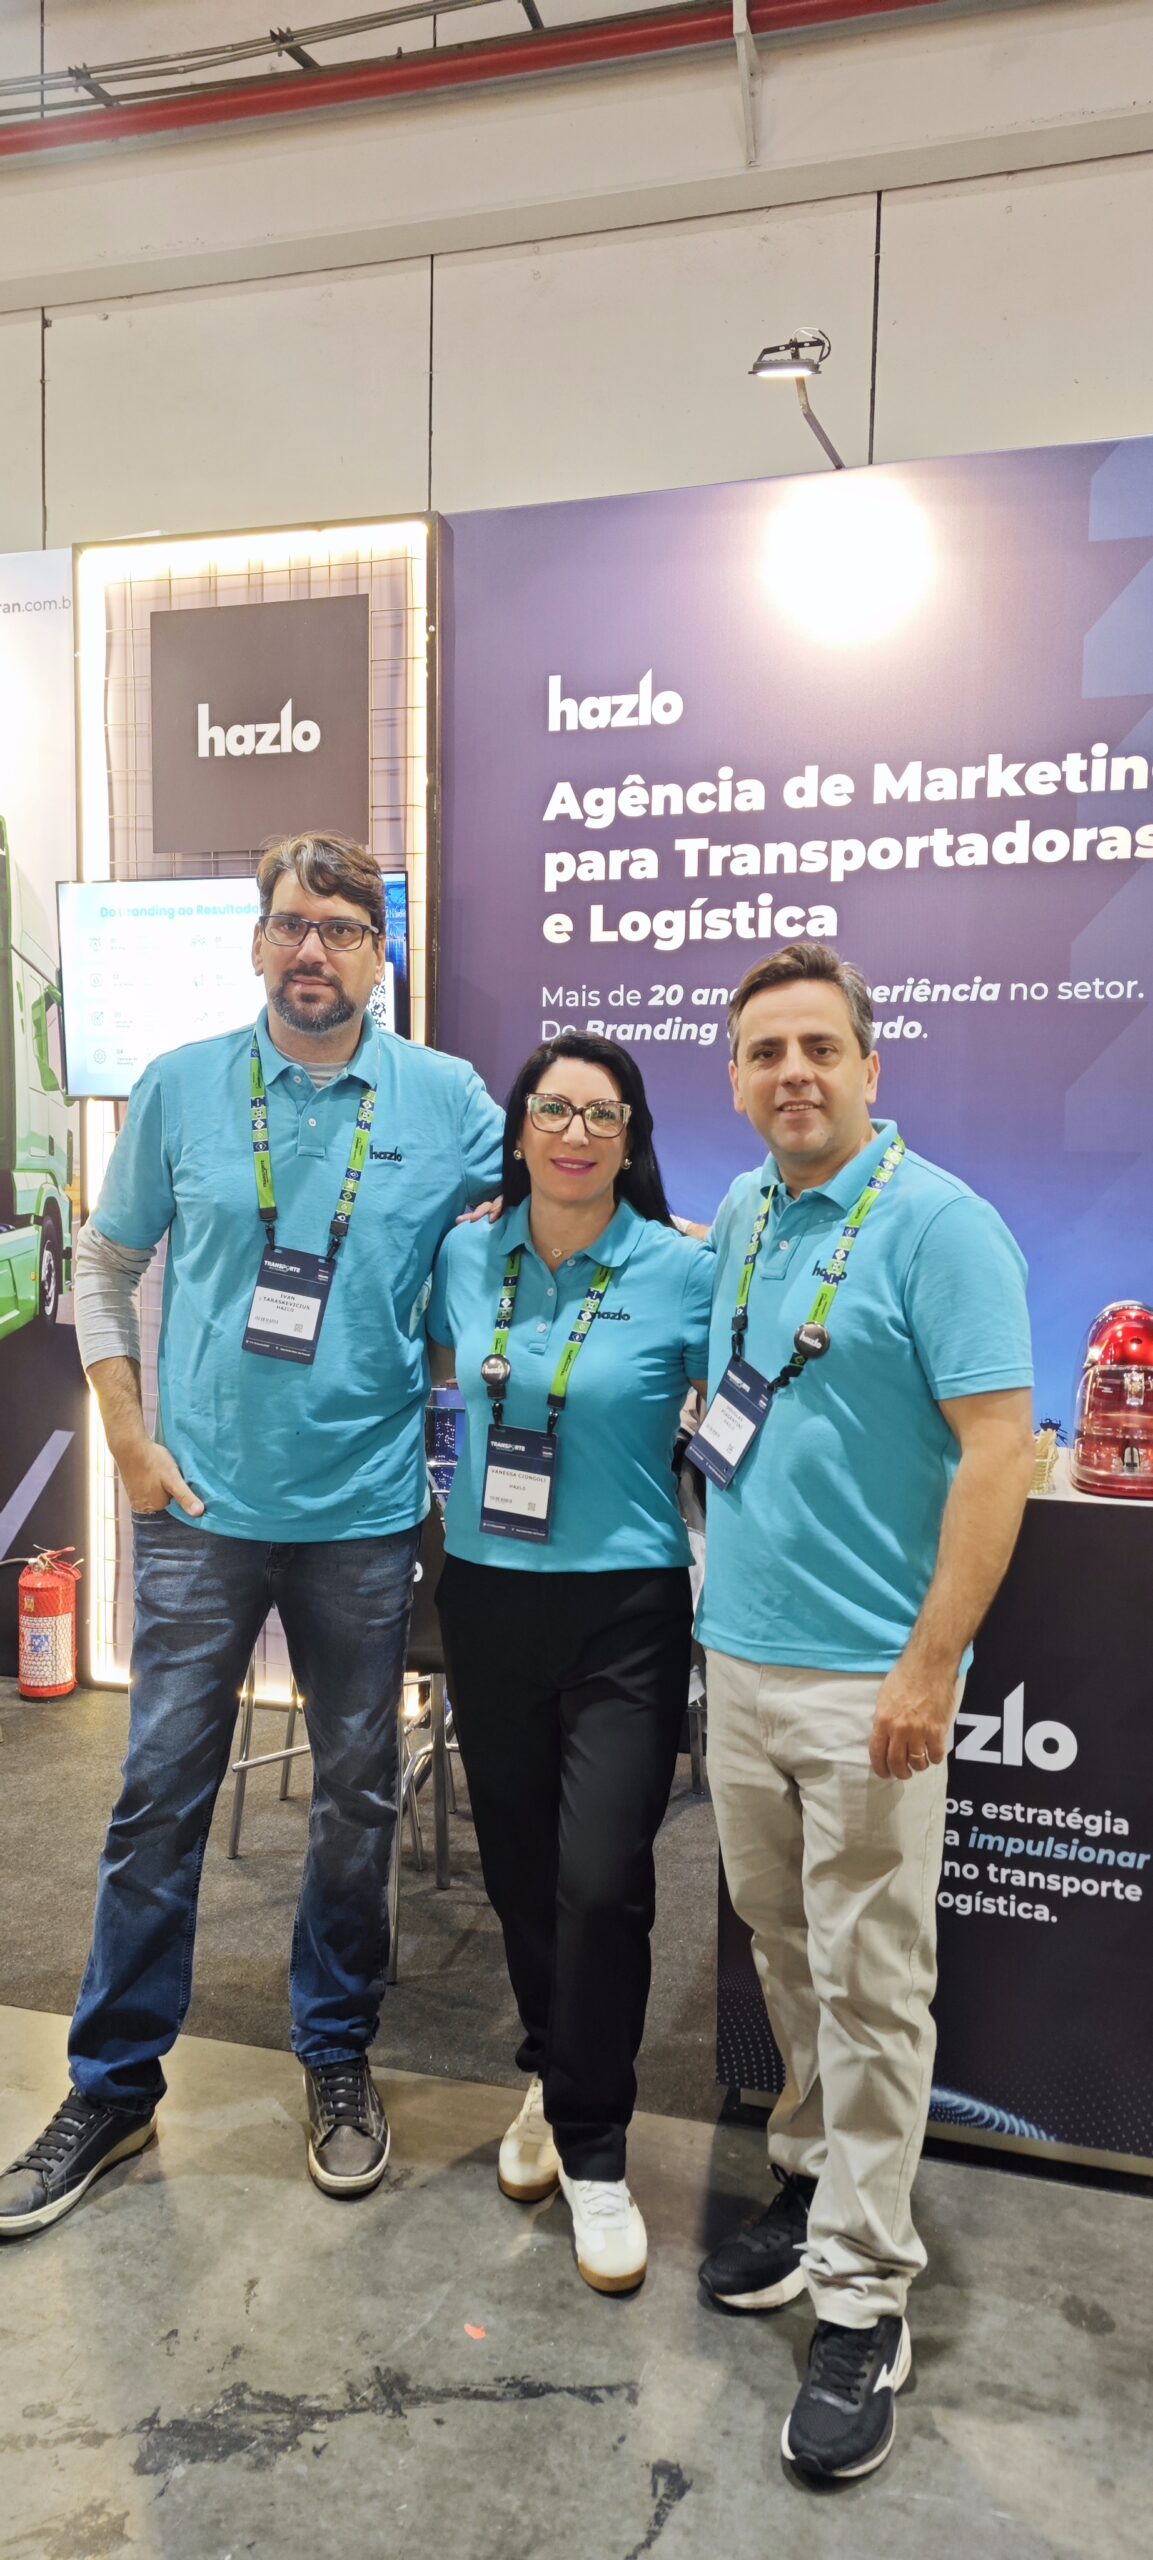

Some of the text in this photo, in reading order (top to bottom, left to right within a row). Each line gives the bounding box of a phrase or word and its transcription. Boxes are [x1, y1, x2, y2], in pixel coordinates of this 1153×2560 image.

[548, 668, 684, 732] hazlo
[197, 698, 321, 758] hazlo
[542, 743, 1153, 829] Agência de Marketin
[544, 820, 1153, 893] para Transportadoras
[119, 904, 175, 920] randing
[542, 893, 838, 951] e Logística
[542, 985, 601, 1007] Mais
[608, 984, 642, 1007] de
[648, 984, 684, 1006] 20
[1010, 982, 1049, 1001] no
[1057, 977, 1145, 1000] setor.
[586, 1016, 719, 1046] Branding
[369, 1144, 403, 1162] hazlo
[811, 1259, 848, 1281] hao
[955, 1681, 1078, 1772] zlo
[981, 1803, 1130, 1837] estratégia
[968, 1826, 1151, 1870] impulsionar
[944, 1860, 1143, 1902] no transporte
[937, 1890, 1058, 1924] ogística.
